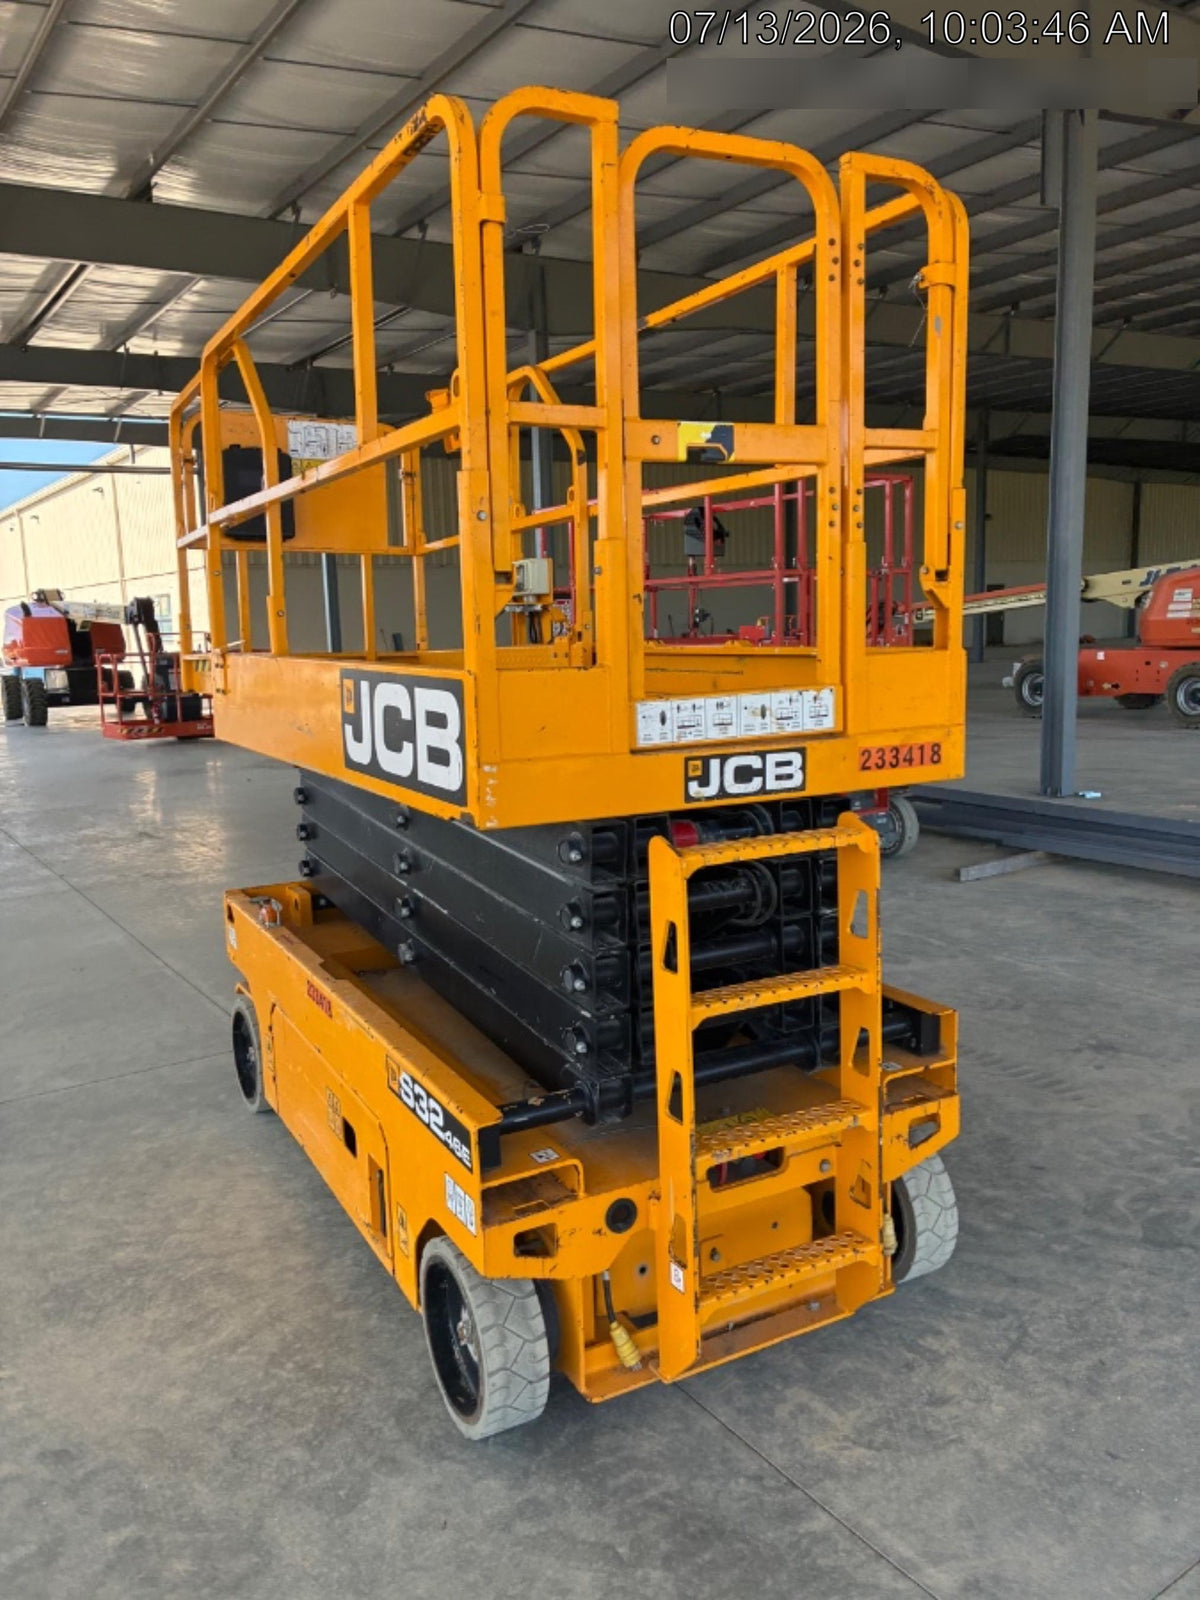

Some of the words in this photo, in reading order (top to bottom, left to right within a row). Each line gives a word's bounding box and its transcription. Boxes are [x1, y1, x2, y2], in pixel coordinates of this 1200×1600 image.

[344, 680, 463, 791] JCB
[860, 743, 942, 771] 233418
[687, 752, 804, 798] JCB
